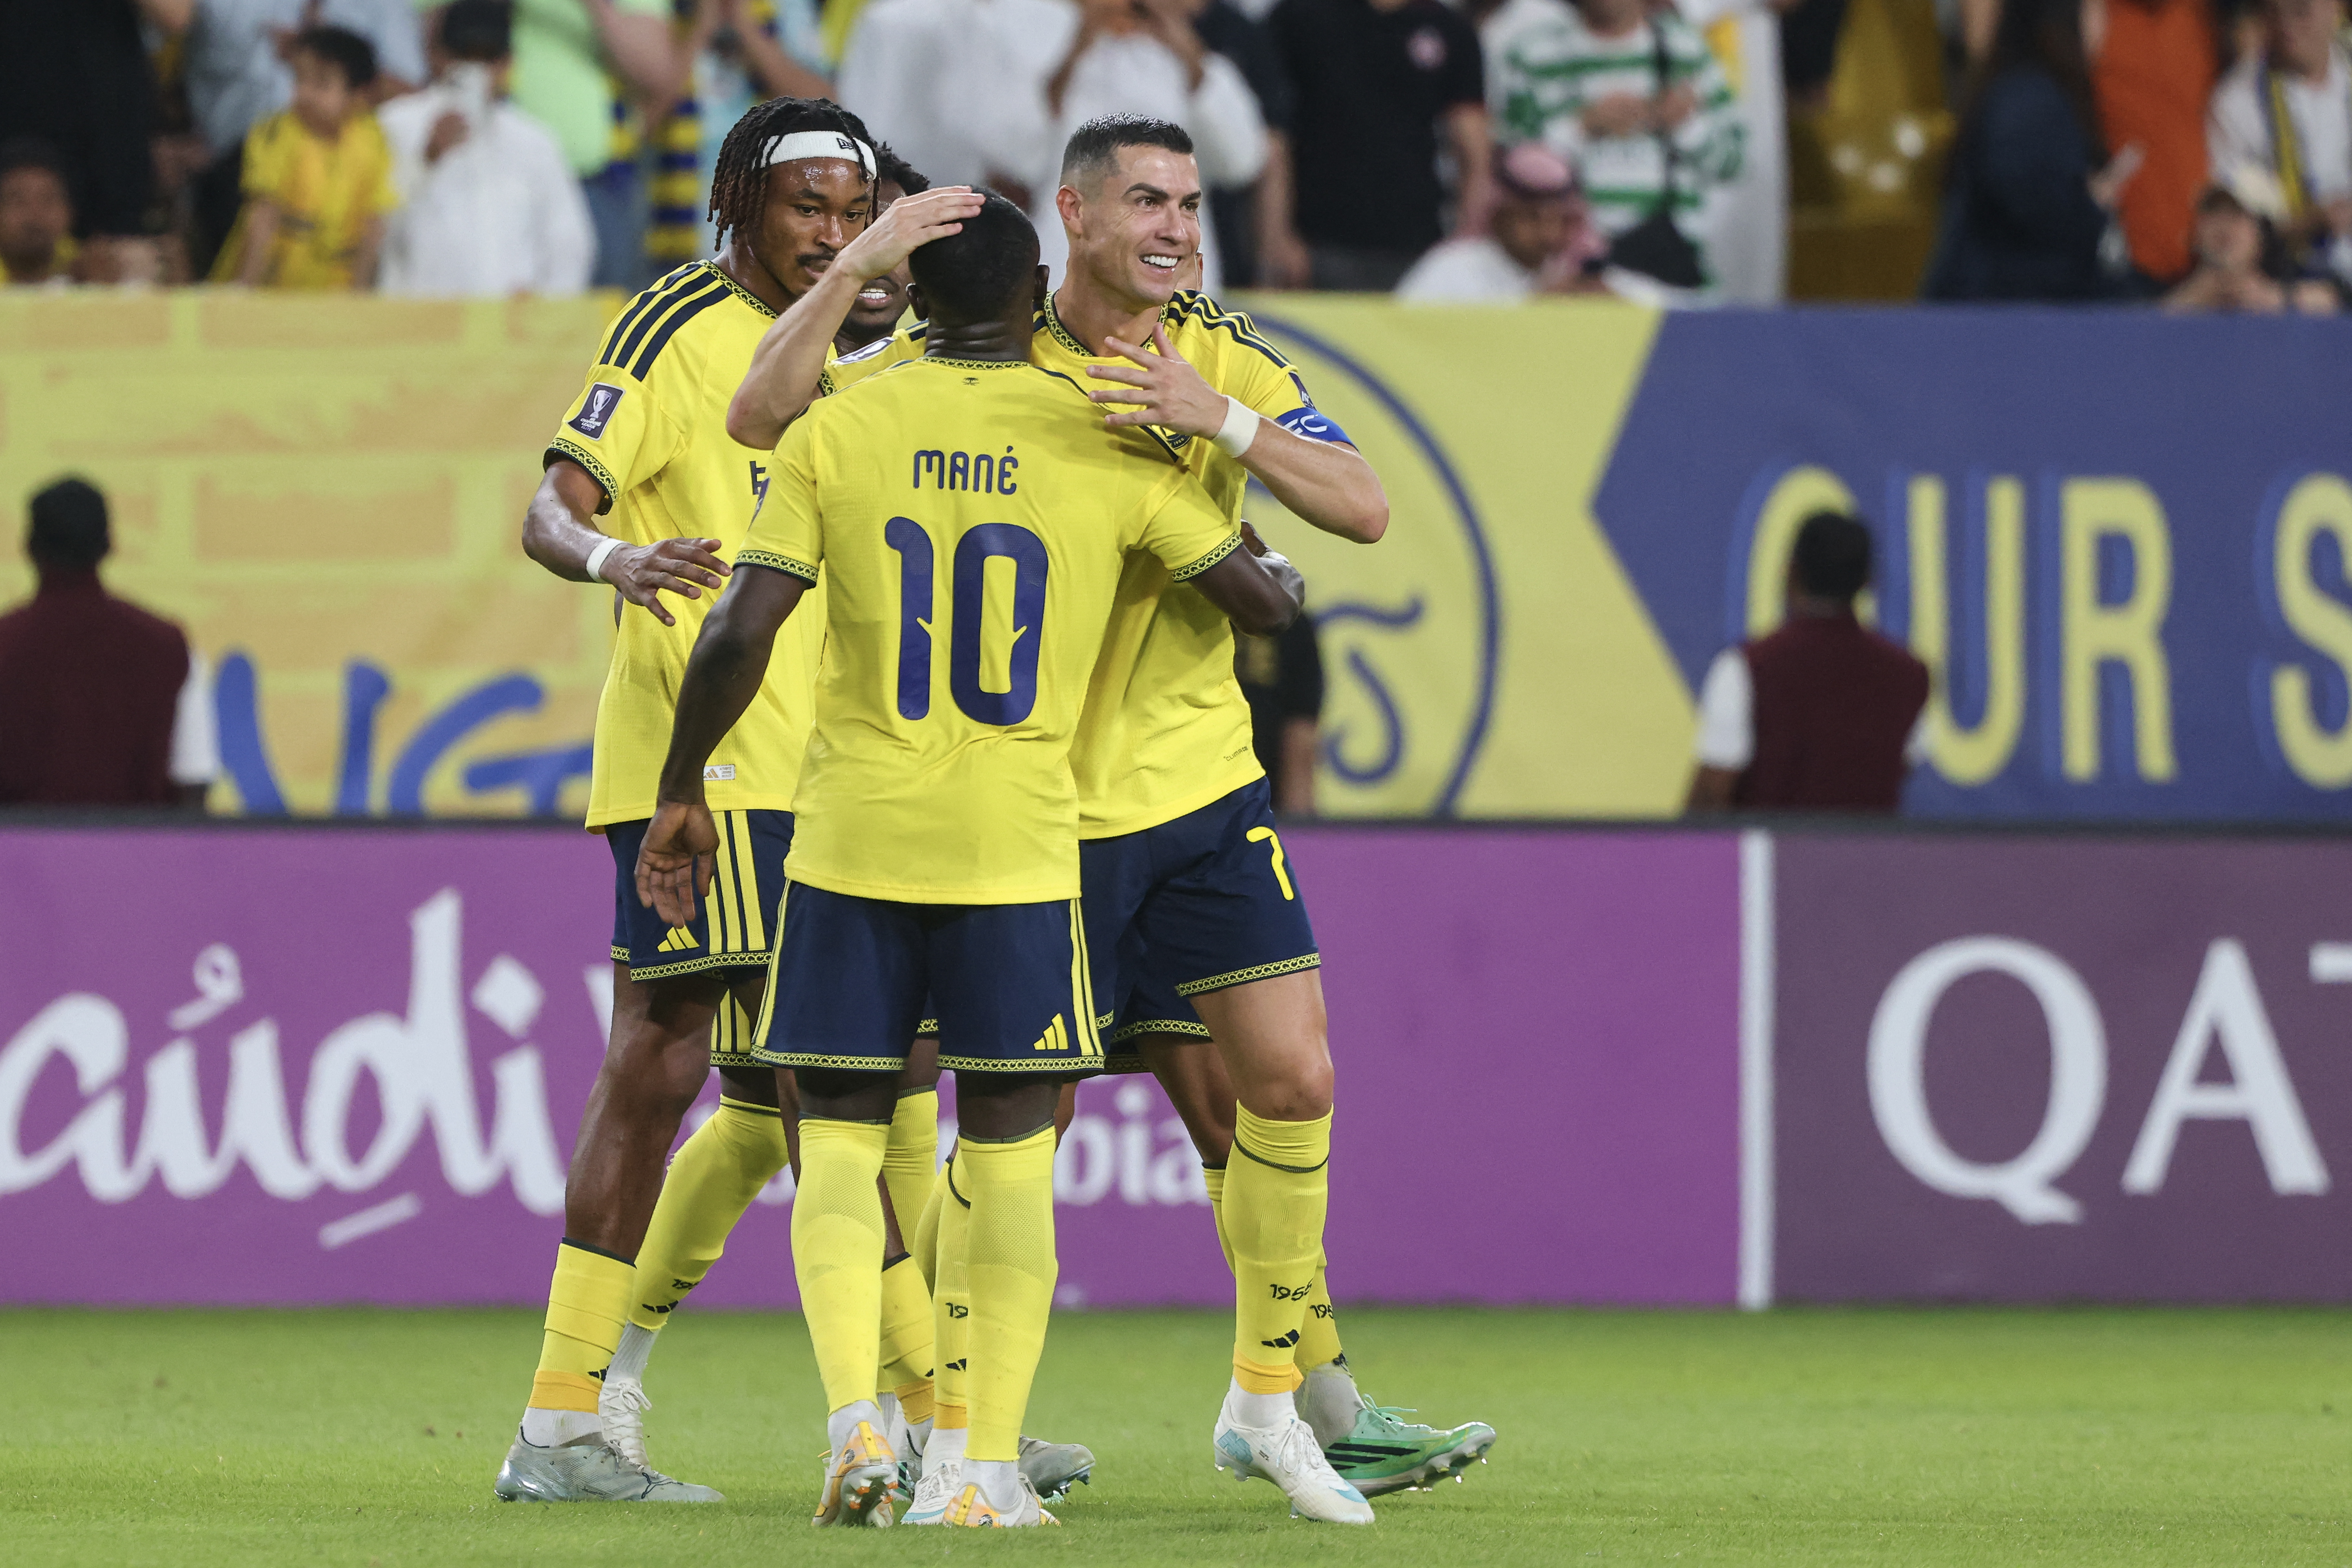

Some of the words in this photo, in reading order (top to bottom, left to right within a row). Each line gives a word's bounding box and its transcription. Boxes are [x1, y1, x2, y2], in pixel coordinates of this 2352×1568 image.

[580, 418, 602, 426] CHAMPIONS
[913, 445, 1018, 495] MANÉ
[884, 516, 1049, 726] 10
[1246, 826, 1294, 900] 7
